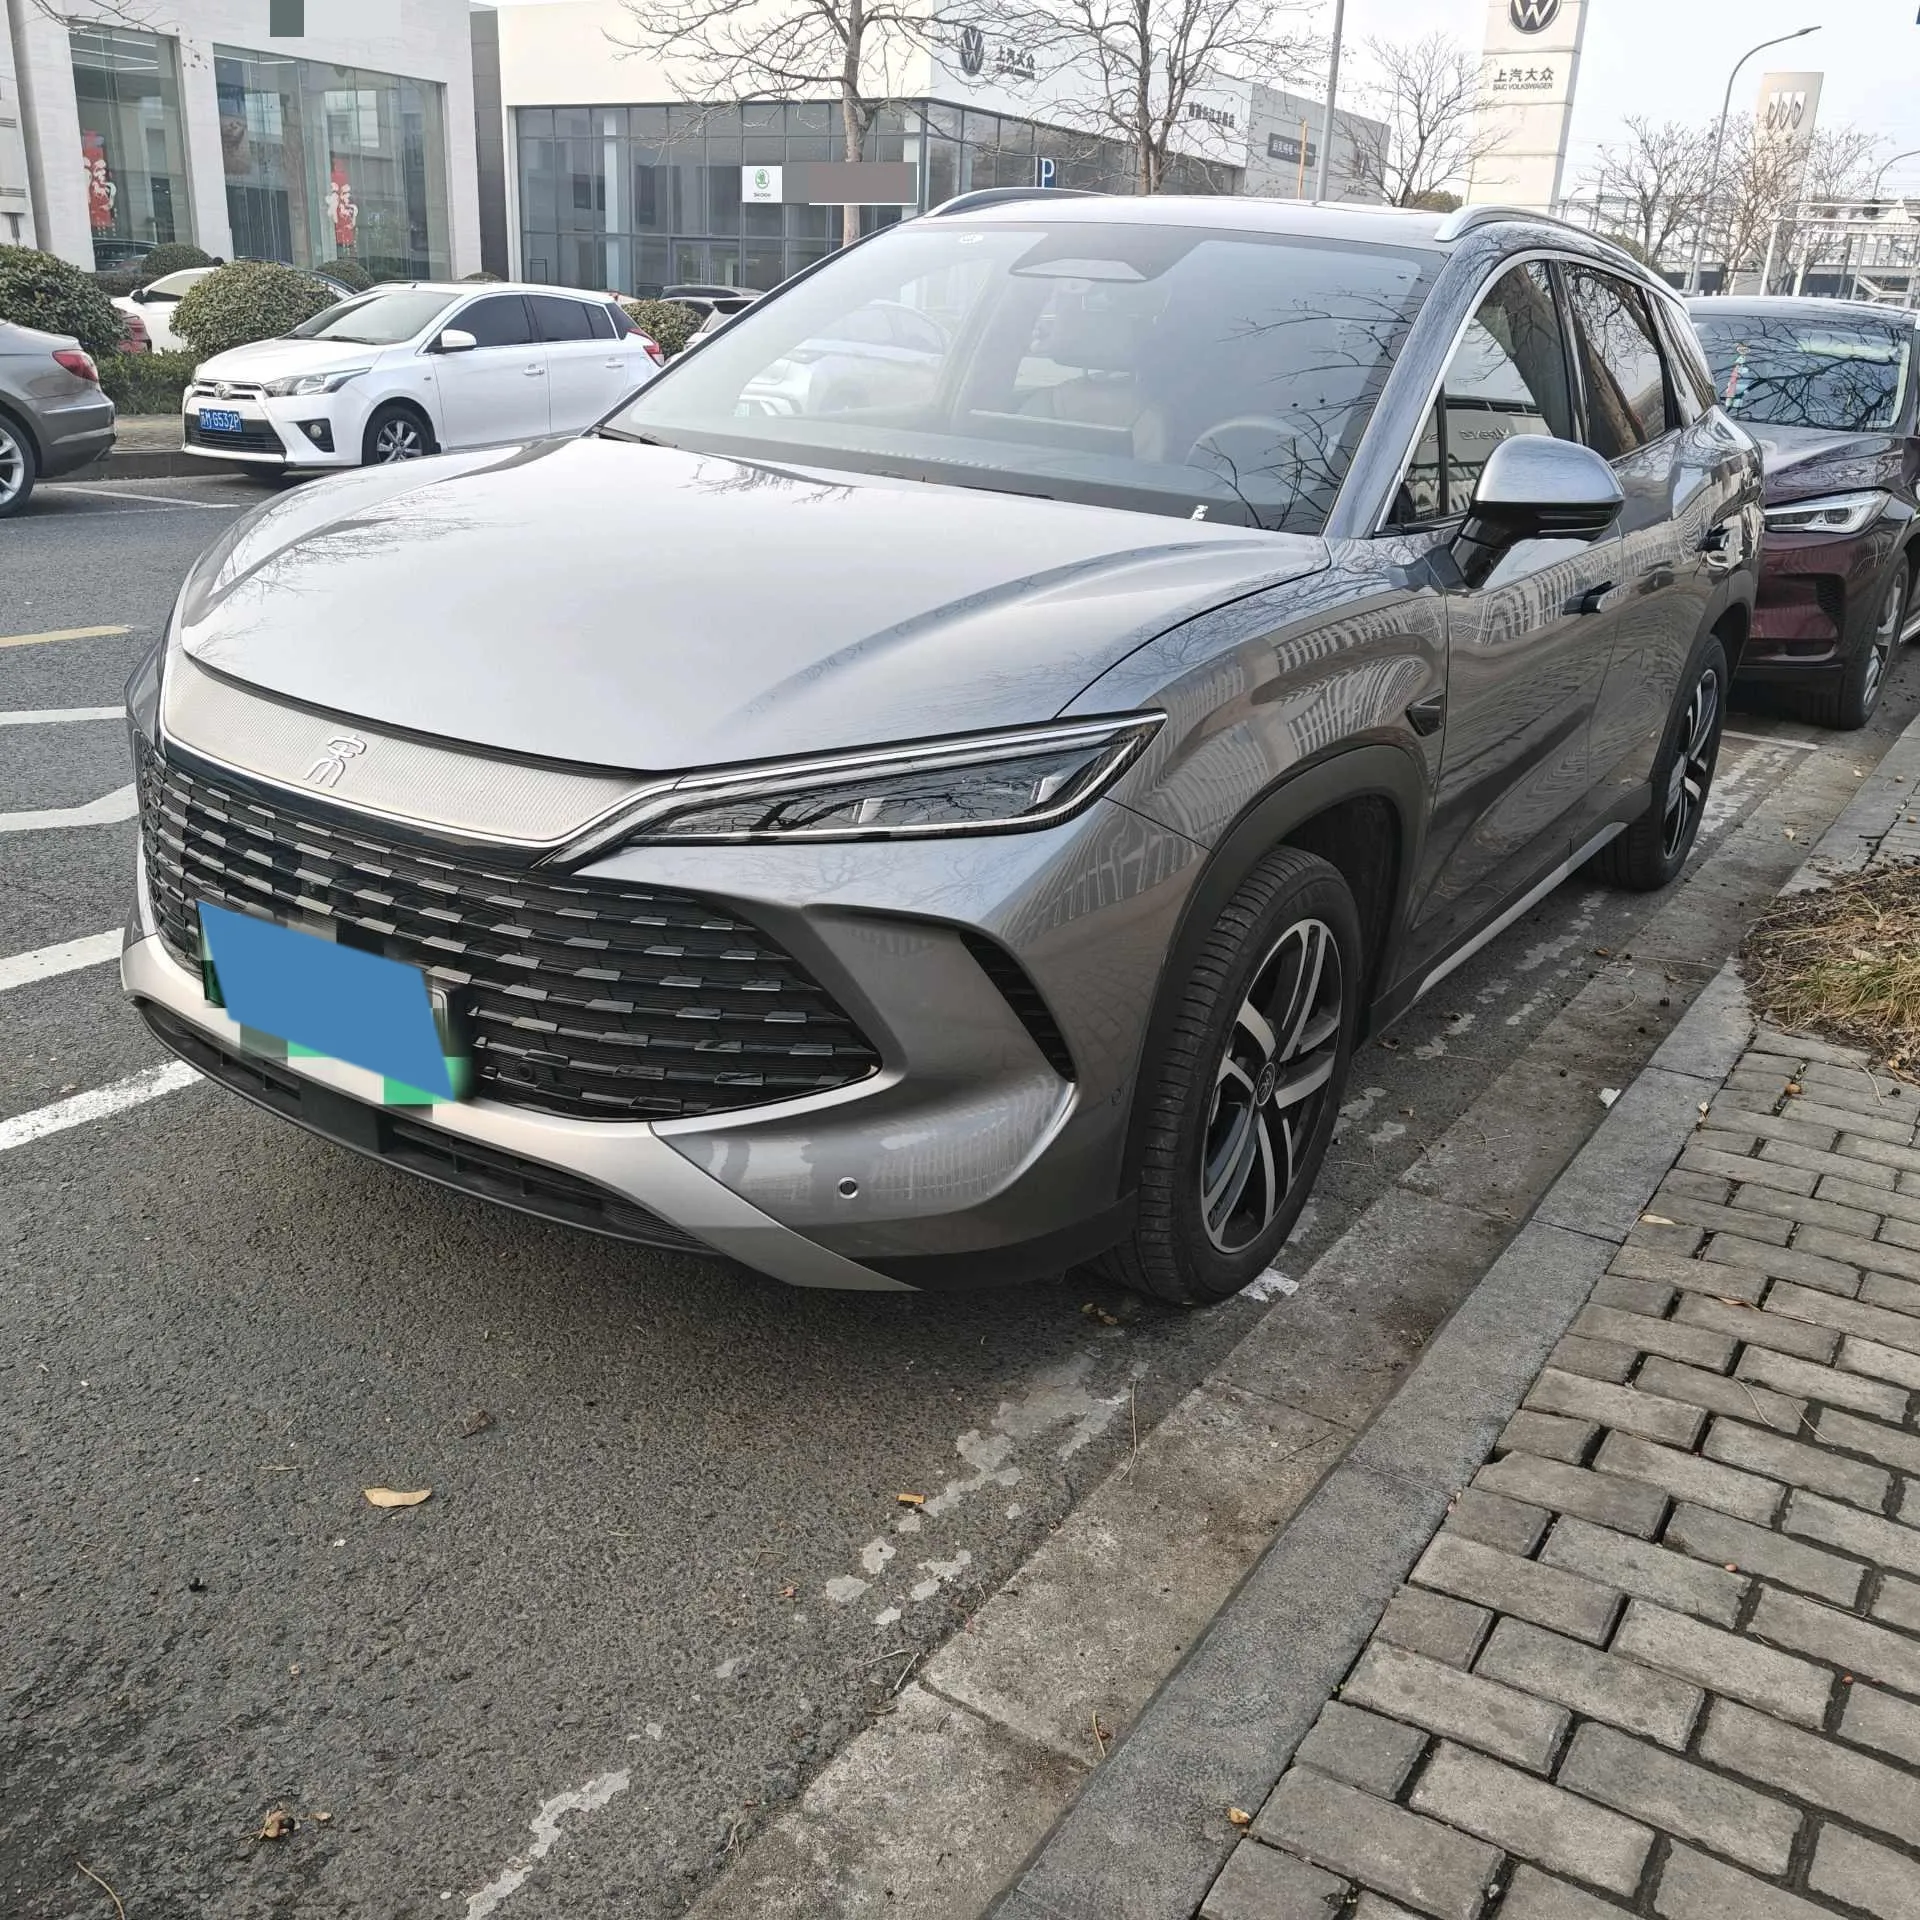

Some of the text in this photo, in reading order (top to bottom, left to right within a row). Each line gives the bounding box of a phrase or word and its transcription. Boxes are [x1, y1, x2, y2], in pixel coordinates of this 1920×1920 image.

[1494, 67, 1554, 82] 上汽大众
[1040, 157, 1055, 188] P
